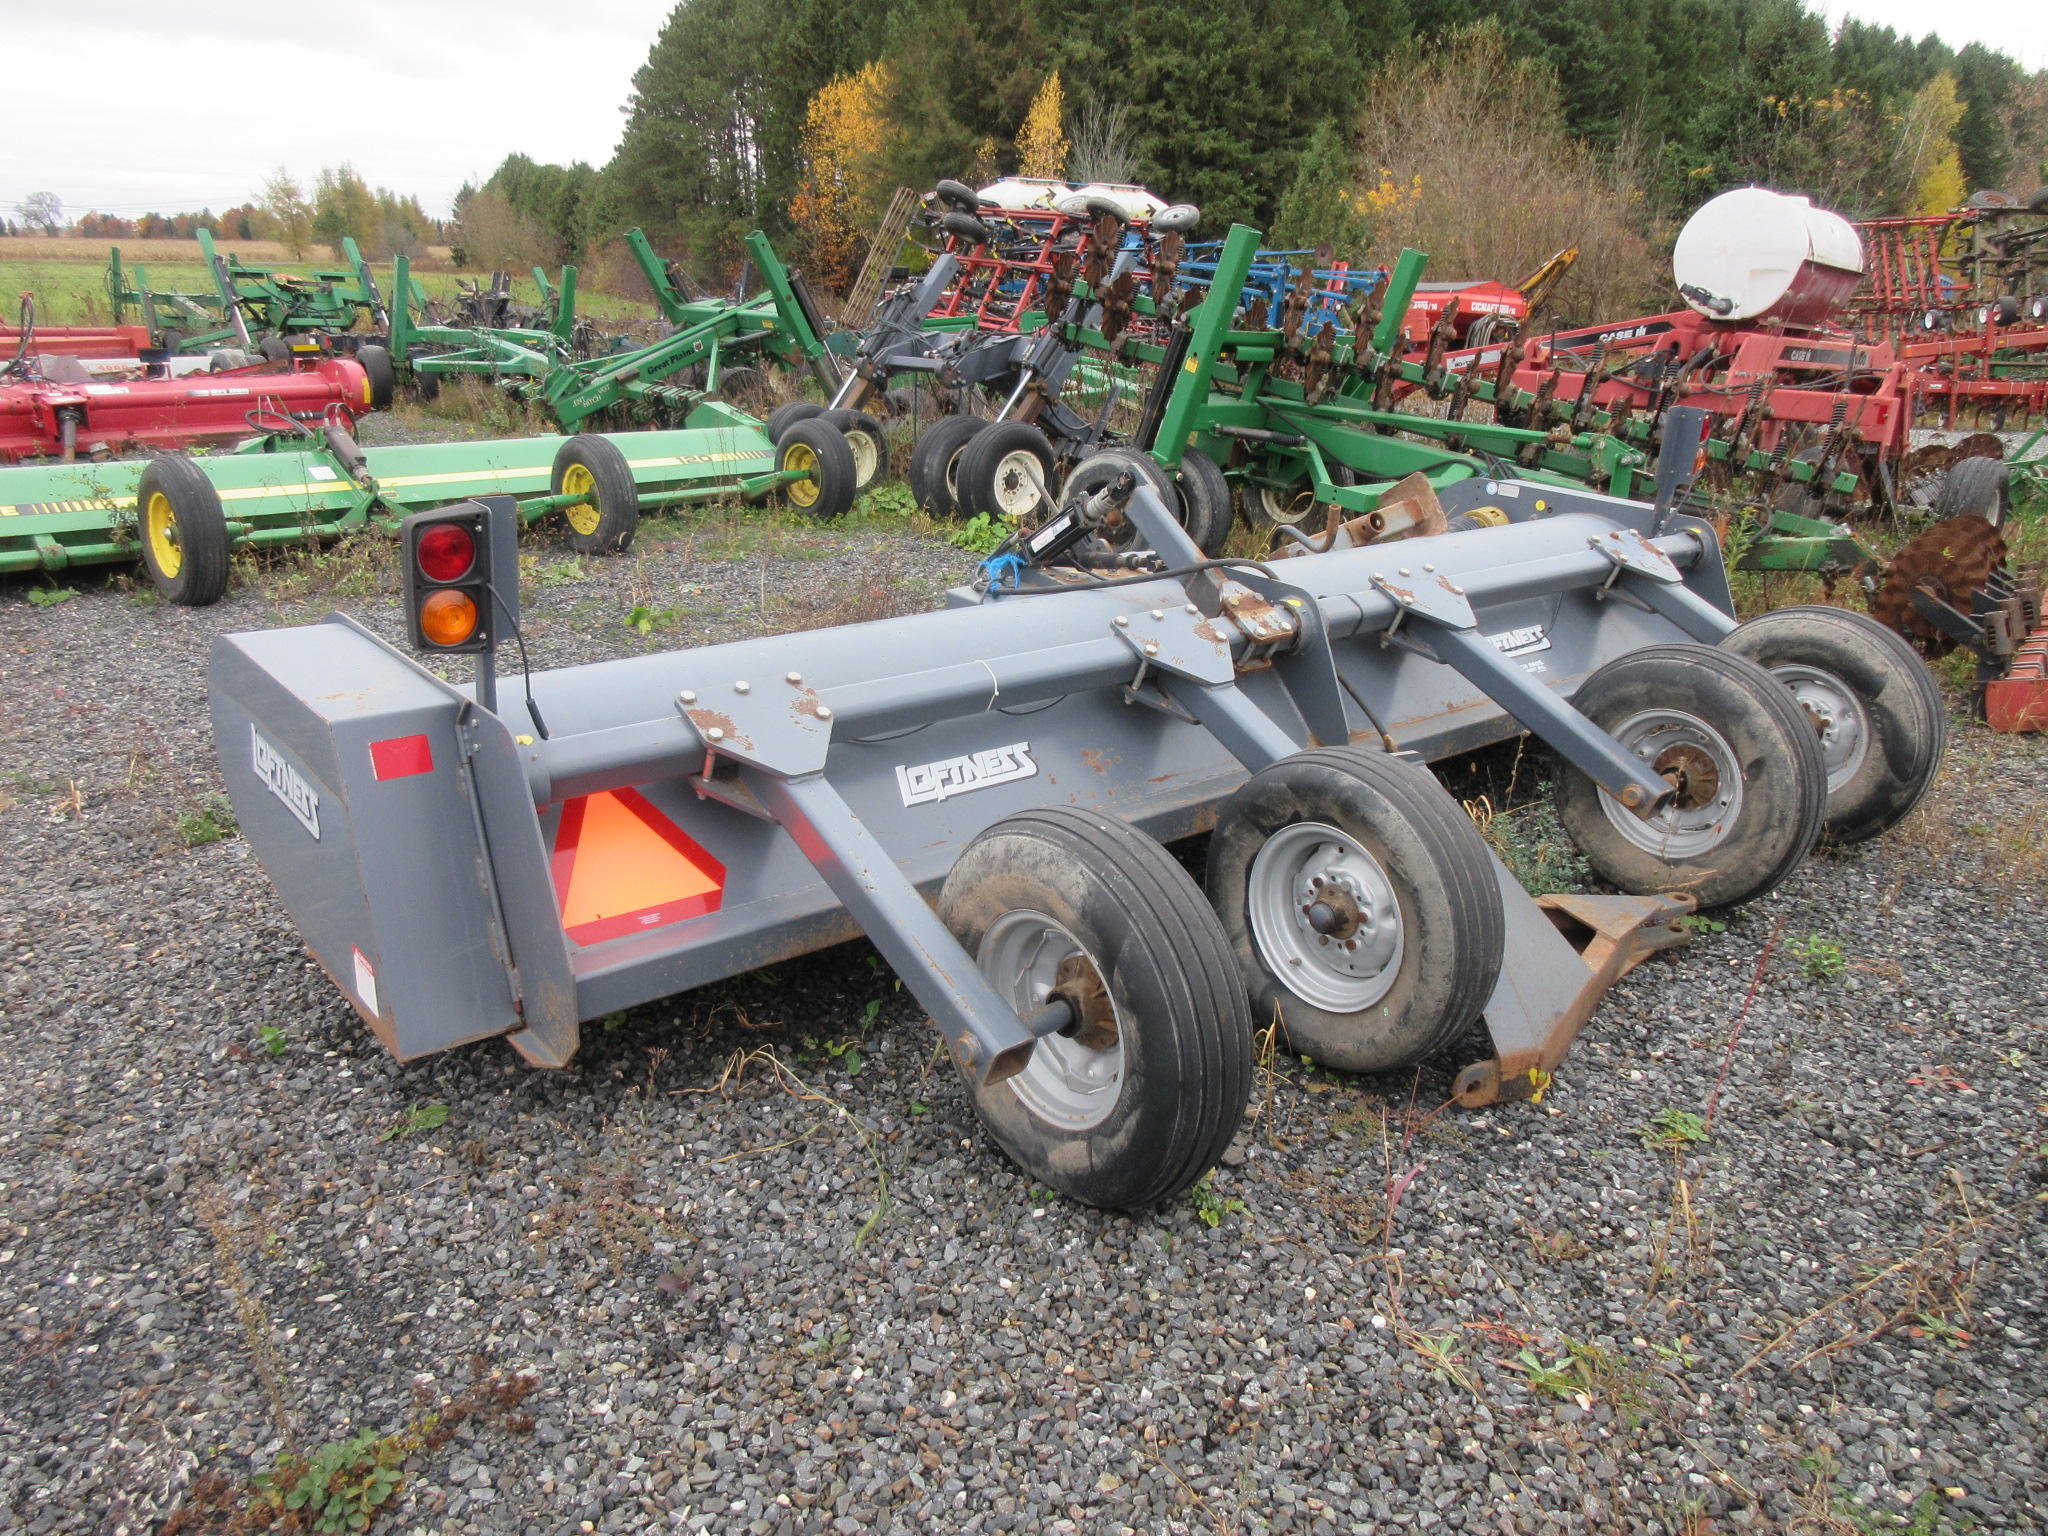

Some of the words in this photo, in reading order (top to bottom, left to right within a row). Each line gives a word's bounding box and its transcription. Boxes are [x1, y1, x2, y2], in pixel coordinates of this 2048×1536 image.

[1600, 330, 1633, 342] CASE
[647, 359, 670, 375] Great
[251, 723, 320, 841] LOFTNESS
[895, 742, 1038, 808] LOFTNESS
